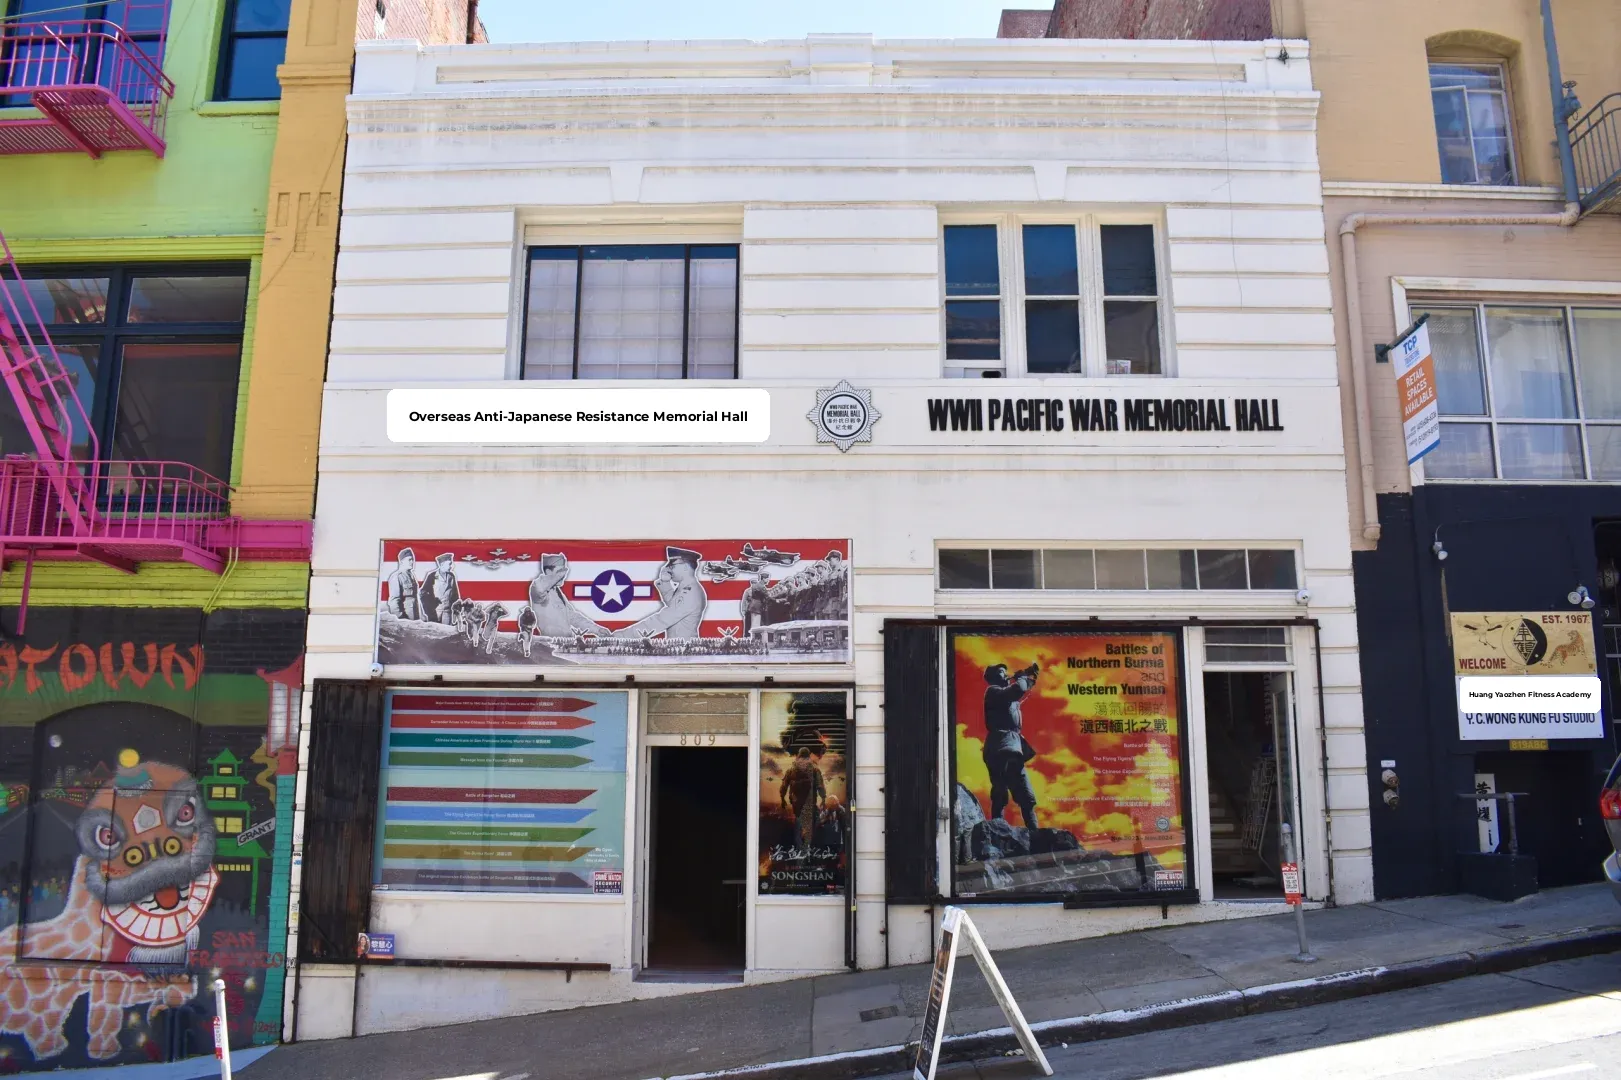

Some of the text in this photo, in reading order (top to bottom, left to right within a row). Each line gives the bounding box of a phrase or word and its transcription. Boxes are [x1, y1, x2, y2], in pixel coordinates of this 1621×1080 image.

[1403, 335, 1418, 355] TCP
[1406, 367, 1425, 388] RETAIL
[1406, 378, 1427, 401] SPACES
[1405, 387, 1433, 416] AVAILABLE
[826, 410, 861, 418] MEMORIAL HALL
[927, 398, 1284, 433] WWII PACIFIC WAR MEMORIAL HALL
[1542, 614, 1588, 624] EST. 1967
[1105, 643, 1164, 655] Battles of
[1067, 656, 1164, 669] Northern Burma
[1459, 658, 1506, 670] WELCOME
[1141, 672, 1165, 682] and
[1067, 683, 1166, 695] Western Yunnan
[1518, 713, 1546, 724] KUNG
[1549, 713, 1560, 724] FU
[1563, 713, 1596, 723] STUDIO
[680, 734, 715, 746] 809
[1511, 740, 1547, 750] 819ABC
[238, 821, 273, 844] GRANT
[771, 871, 834, 881] SONGSHAN
[212, 931, 257, 949] SAN
[1188, 991, 1232, 1003] LOADING
